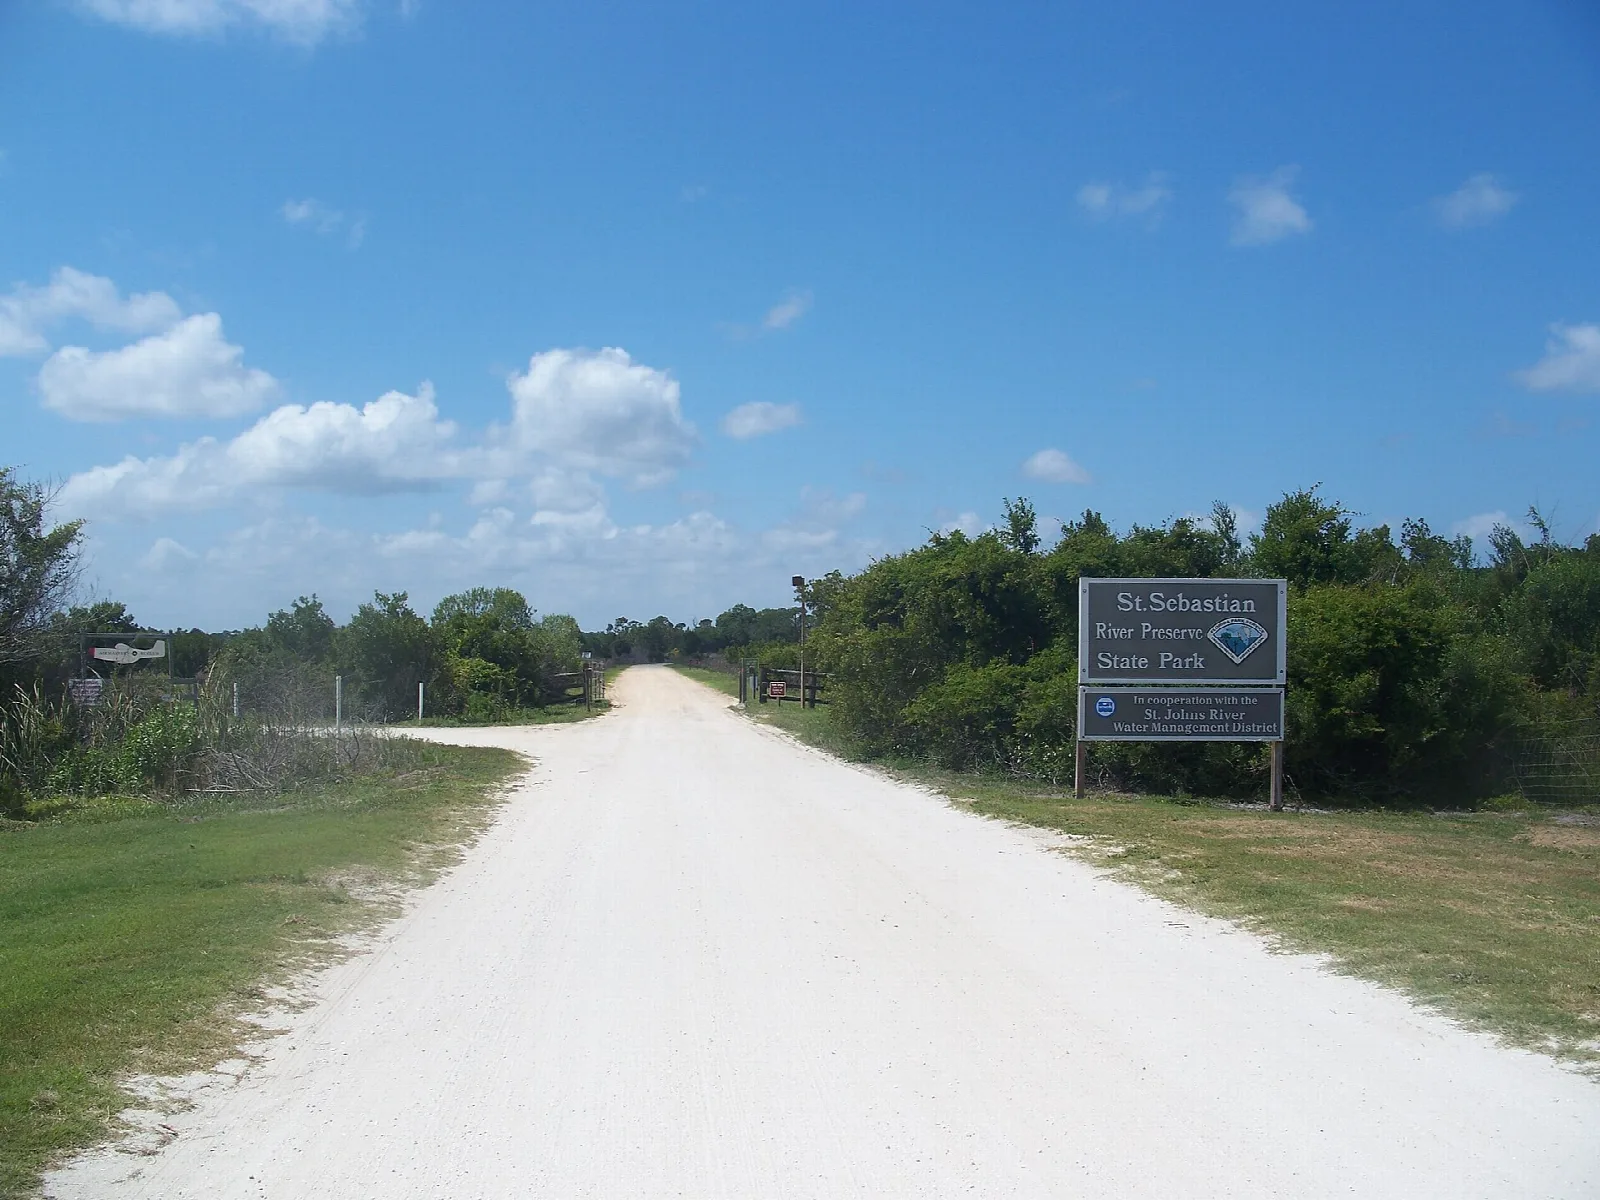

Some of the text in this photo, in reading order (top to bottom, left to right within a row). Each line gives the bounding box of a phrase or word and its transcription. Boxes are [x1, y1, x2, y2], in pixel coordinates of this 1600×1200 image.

[1095, 622, 1203, 640] River Preserve
[1097, 652, 1205, 669] State Park
[1133, 695, 1258, 707] In cooperation with the
[1144, 708, 1246, 720] St. Johns River
[1113, 722, 1278, 735] Water Management District
